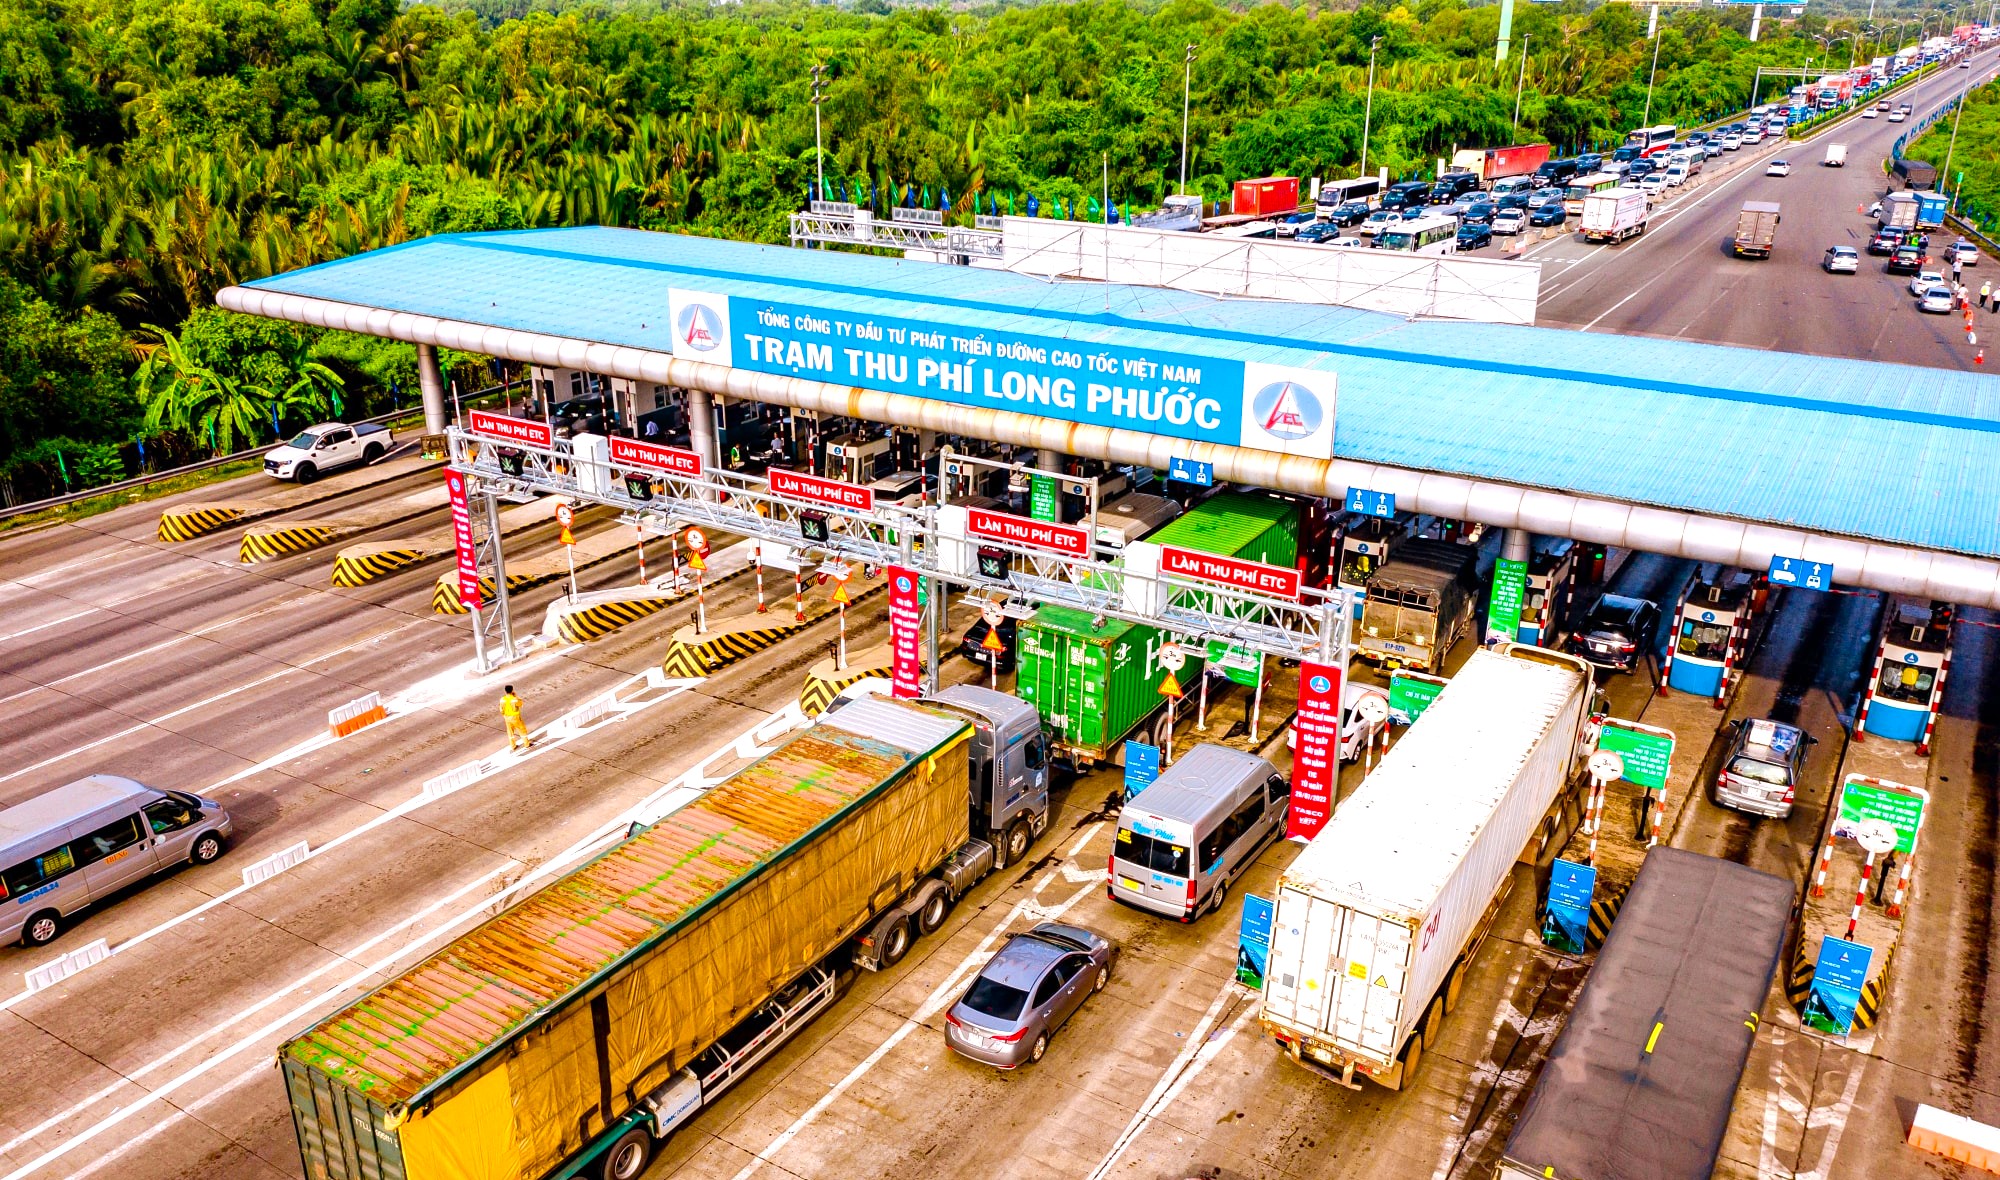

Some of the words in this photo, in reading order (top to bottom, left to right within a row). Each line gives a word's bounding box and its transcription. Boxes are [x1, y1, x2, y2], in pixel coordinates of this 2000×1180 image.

[757, 306, 791, 329] TỔNG
[794, 315, 831, 335] CÔNG
[835, 321, 852, 336] TY
[856, 320, 883, 342] ĐẦU
[887, 327, 905, 345] TƯ
[911, 331, 946, 351] PHÁT
[952, 333, 992, 357] TRIỂN
[996, 341, 1046, 365] ĐƯỜNG
[1051, 350, 1082, 369] CAO
[1086, 352, 1119, 375] TỐC
[1123, 357, 1158, 381] VIỆT
[1162, 364, 1201, 385] NAM
[744, 333, 834, 373] TRẠM
[843, 348, 908, 383] THU
[917, 357, 973, 394] PHÍ
[983, 371, 1076, 409] LONG
[1087, 385, 1221, 430] PHƯỚC
[478, 418, 494, 431] LÀN
[497, 422, 512, 435] THU
[513, 424, 527, 437] PHÍ
[529, 428, 545, 441] ETC
[618, 444, 635, 458] LÀN
[638, 449, 656, 462] THU
[658, 452, 674, 465] PHÍ
[676, 456, 693, 470] ETC
[777, 476, 797, 491] LÀN
[801, 482, 821, 496] THU
[824, 485, 842, 500] PHÍ
[844, 490, 863, 505] ETC
[977, 516, 1001, 533] LÀN
[1004, 523, 1028, 538] THU
[1031, 527, 1052, 543] PHÍ
[1054, 532, 1078, 548] ETC
[1171, 554, 1199, 572] LÀN
[1203, 561, 1230, 578] THU
[1233, 566, 1257, 584] PHÍ
[1260, 575, 1286, 590] ETC
[1294, 806, 1323, 818] TASCO
